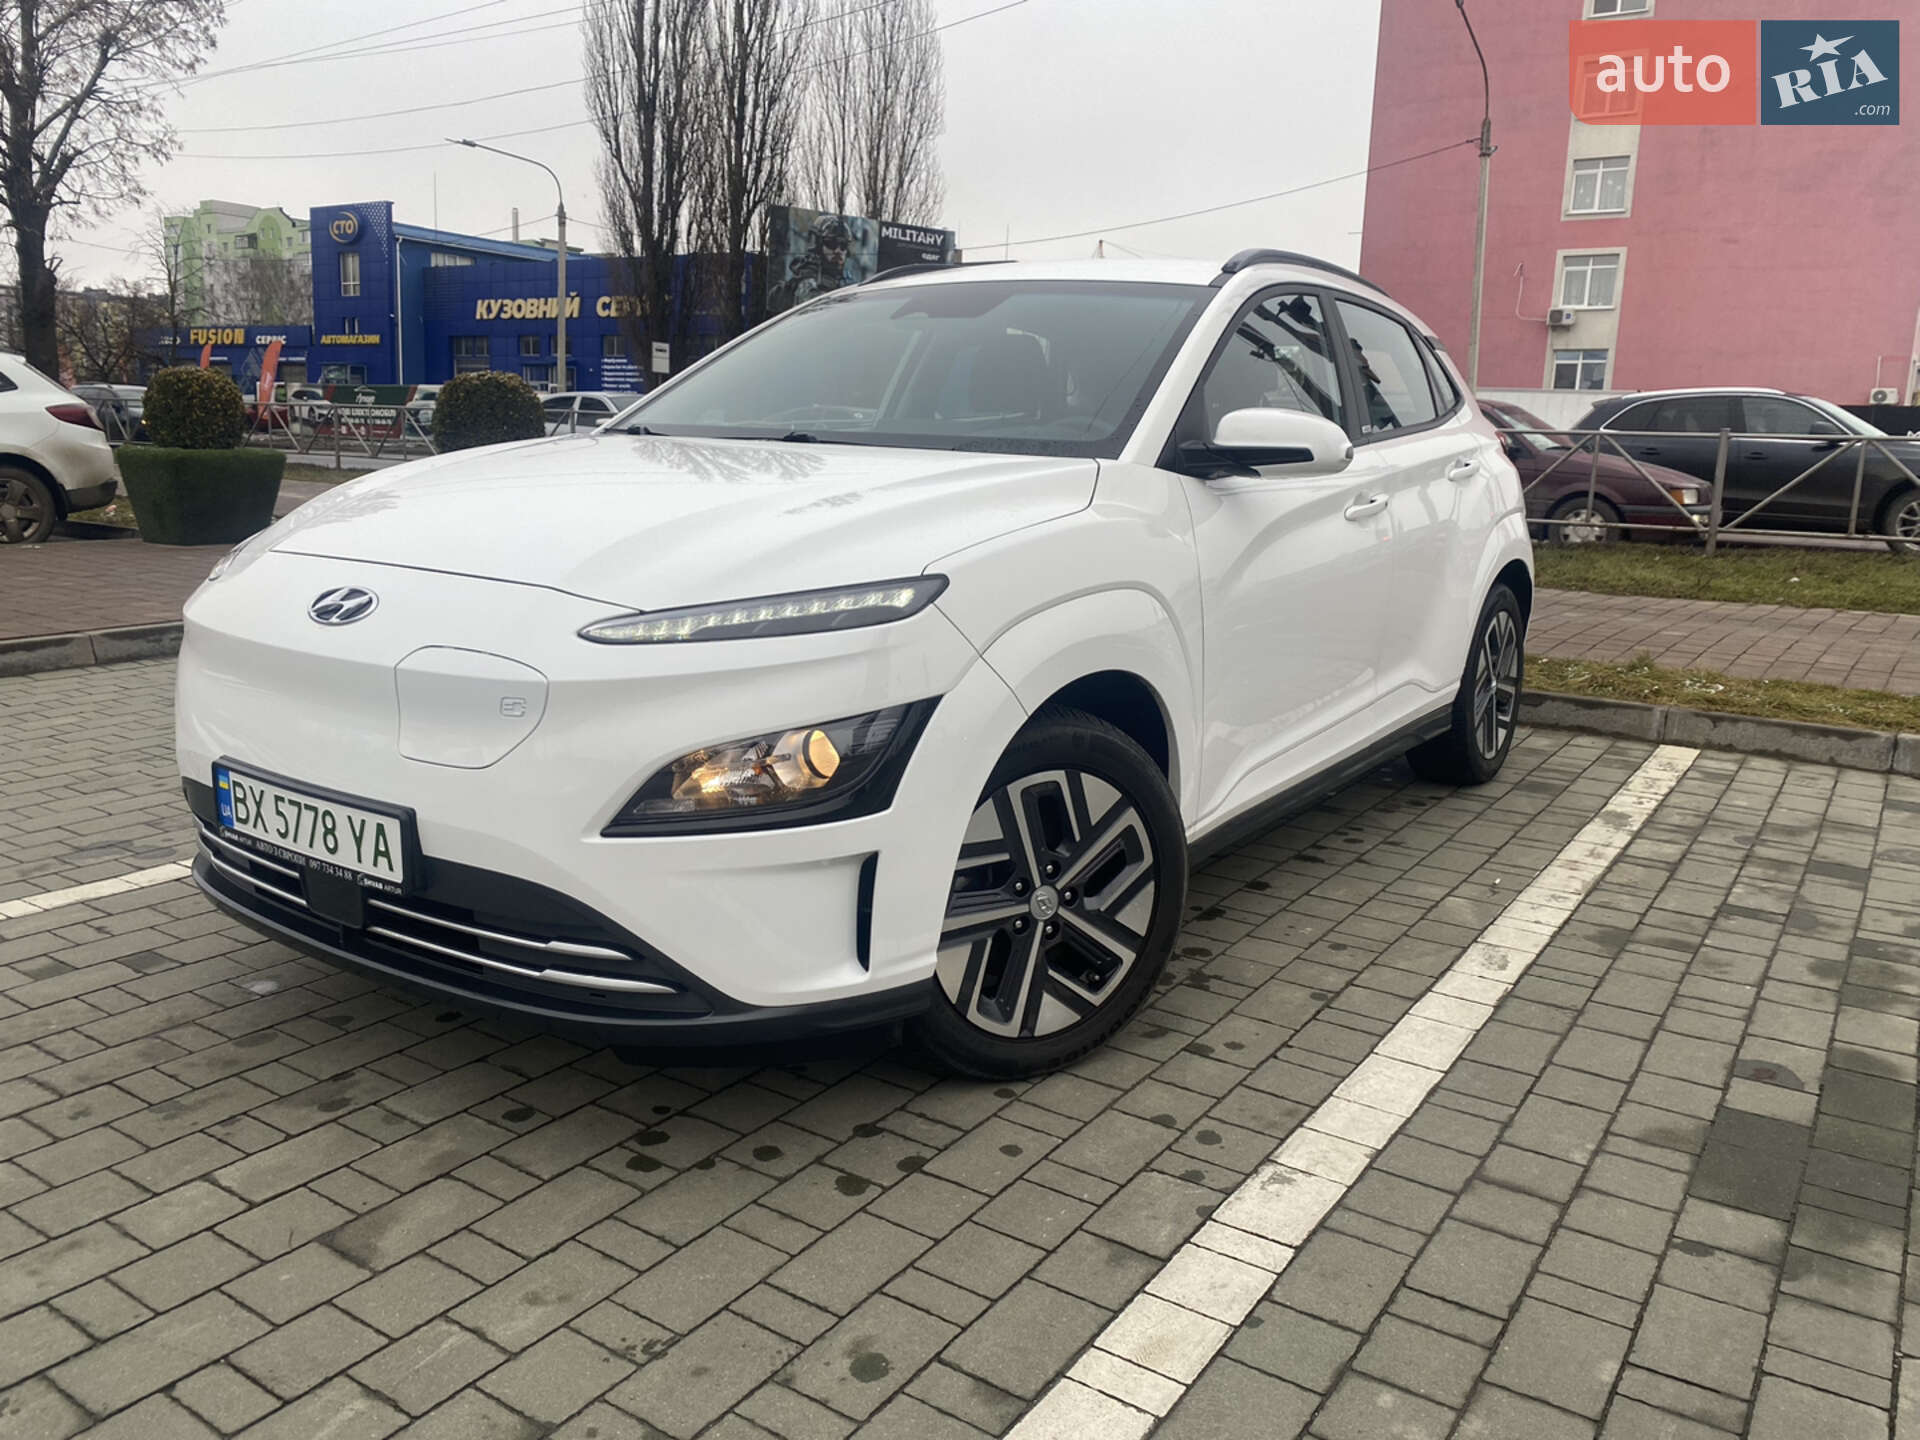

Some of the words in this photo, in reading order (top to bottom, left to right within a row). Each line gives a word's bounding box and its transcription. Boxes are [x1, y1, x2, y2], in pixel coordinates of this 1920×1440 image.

[881, 226, 944, 246] MILITARY
[189, 327, 245, 345] FUSION
[232, 779, 269, 834] BX
[274, 794, 339, 855] 5778
[347, 813, 394, 873] YA
